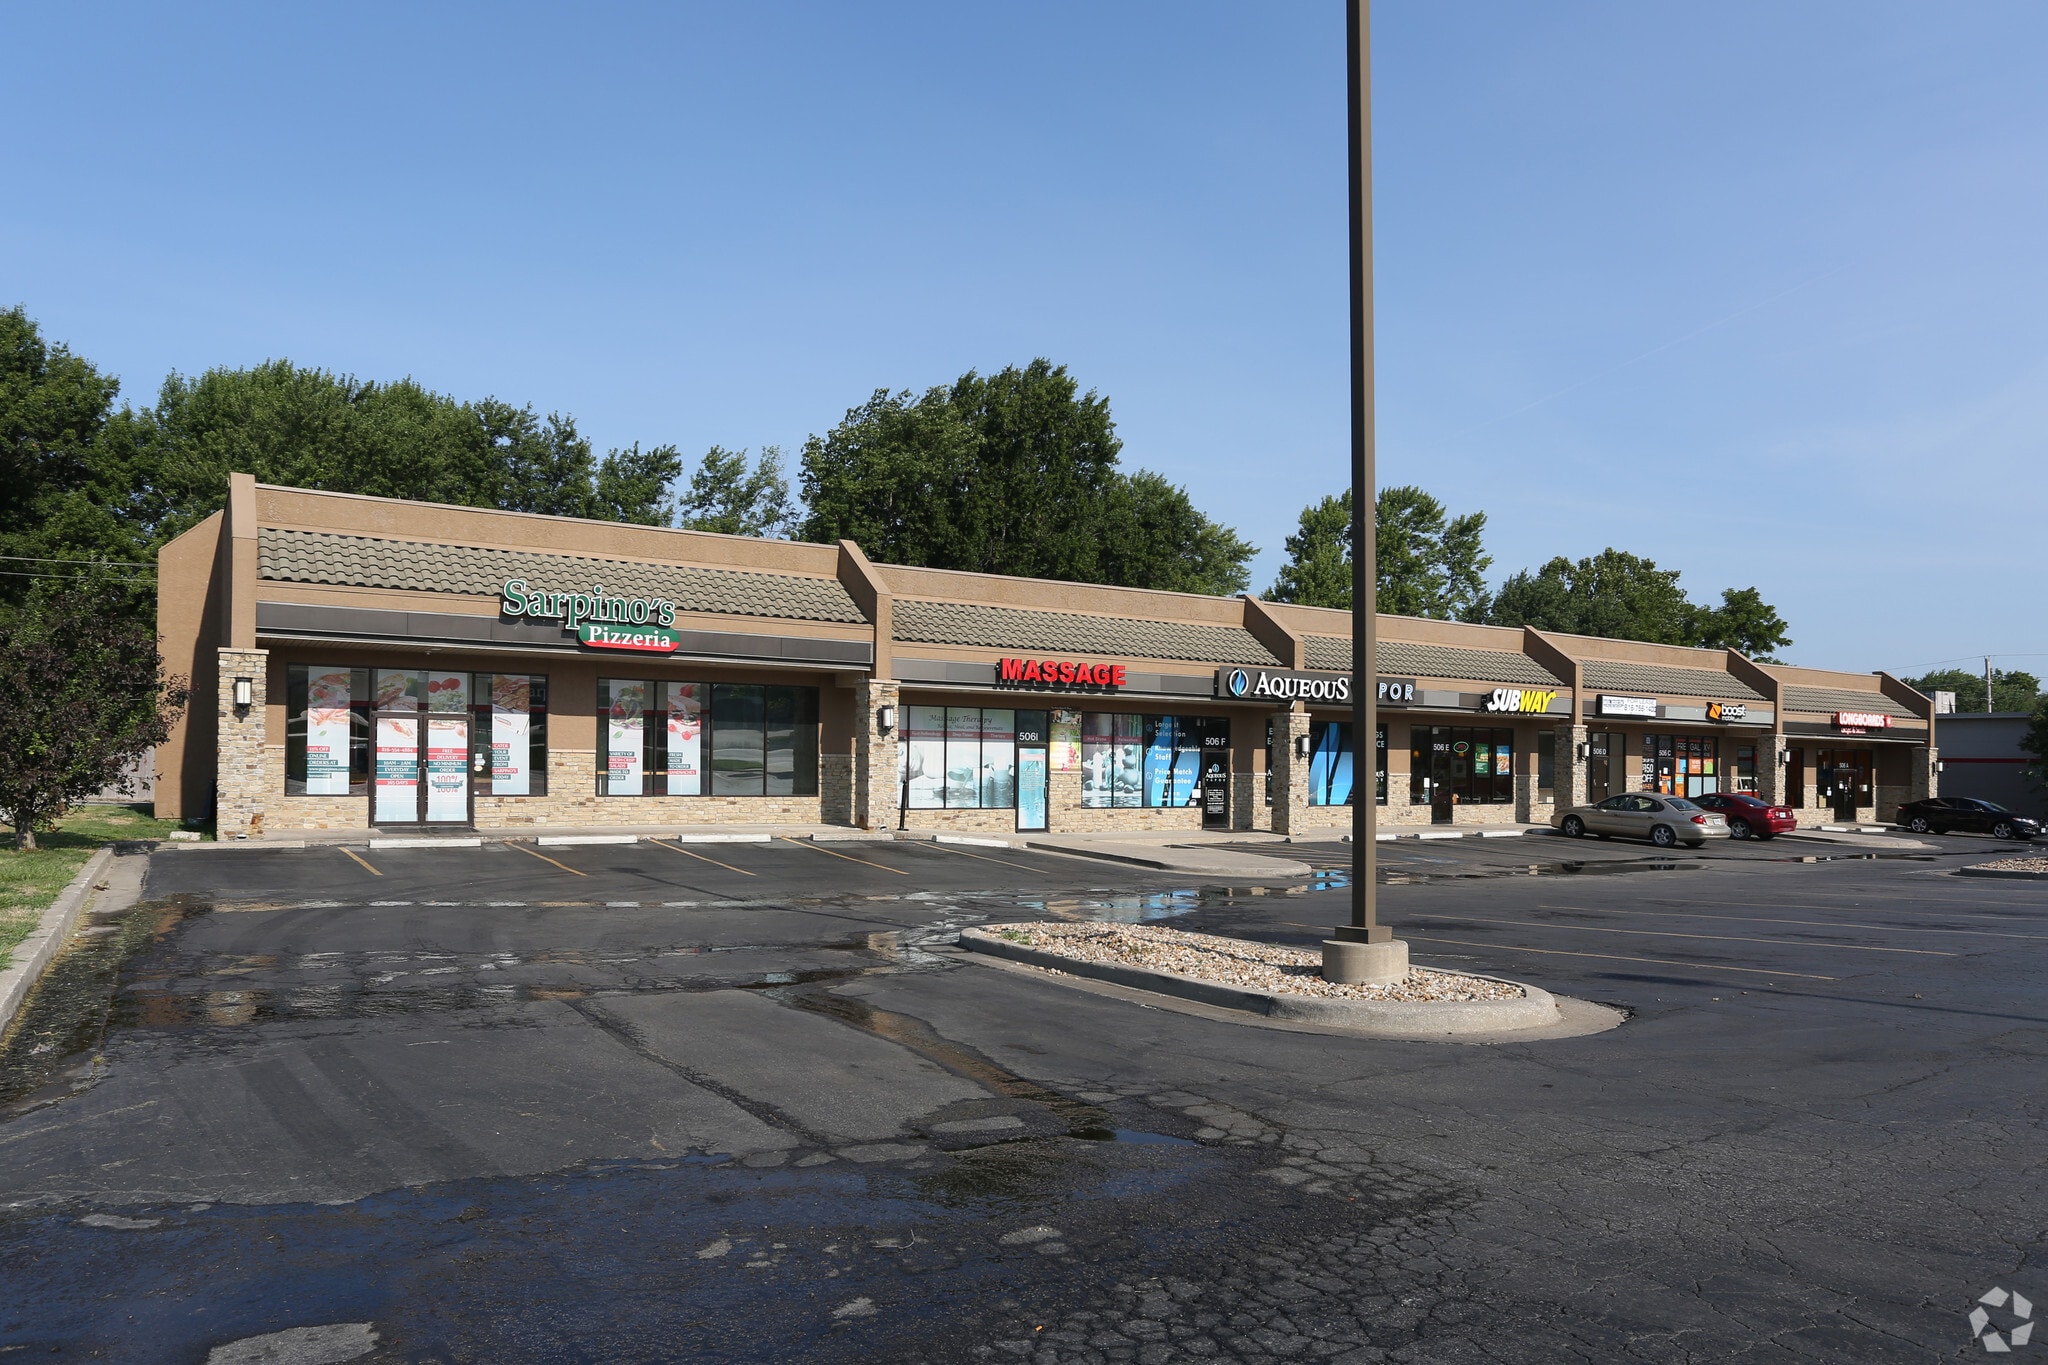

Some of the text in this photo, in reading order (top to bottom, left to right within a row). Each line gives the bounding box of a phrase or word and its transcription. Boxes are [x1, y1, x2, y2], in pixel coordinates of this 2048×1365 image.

[503, 579, 676, 630] Sarpino's
[588, 626, 672, 648] Pizzeria
[1001, 658, 1126, 686] MASSAGE
[1378, 682, 1415, 700] POR
[1487, 688, 1557, 713] SUBWAY
[1721, 703, 1746, 716] boost
[929, 714, 960, 723] Masage
[1839, 712, 1884, 727] LONGBOARDS
[1205, 737, 1220, 746] 506
[1433, 743, 1445, 751] 506
[1593, 747, 1602, 755] 506
[1658, 749, 1668, 757] 506
[1642, 774, 1653, 783] OFF
